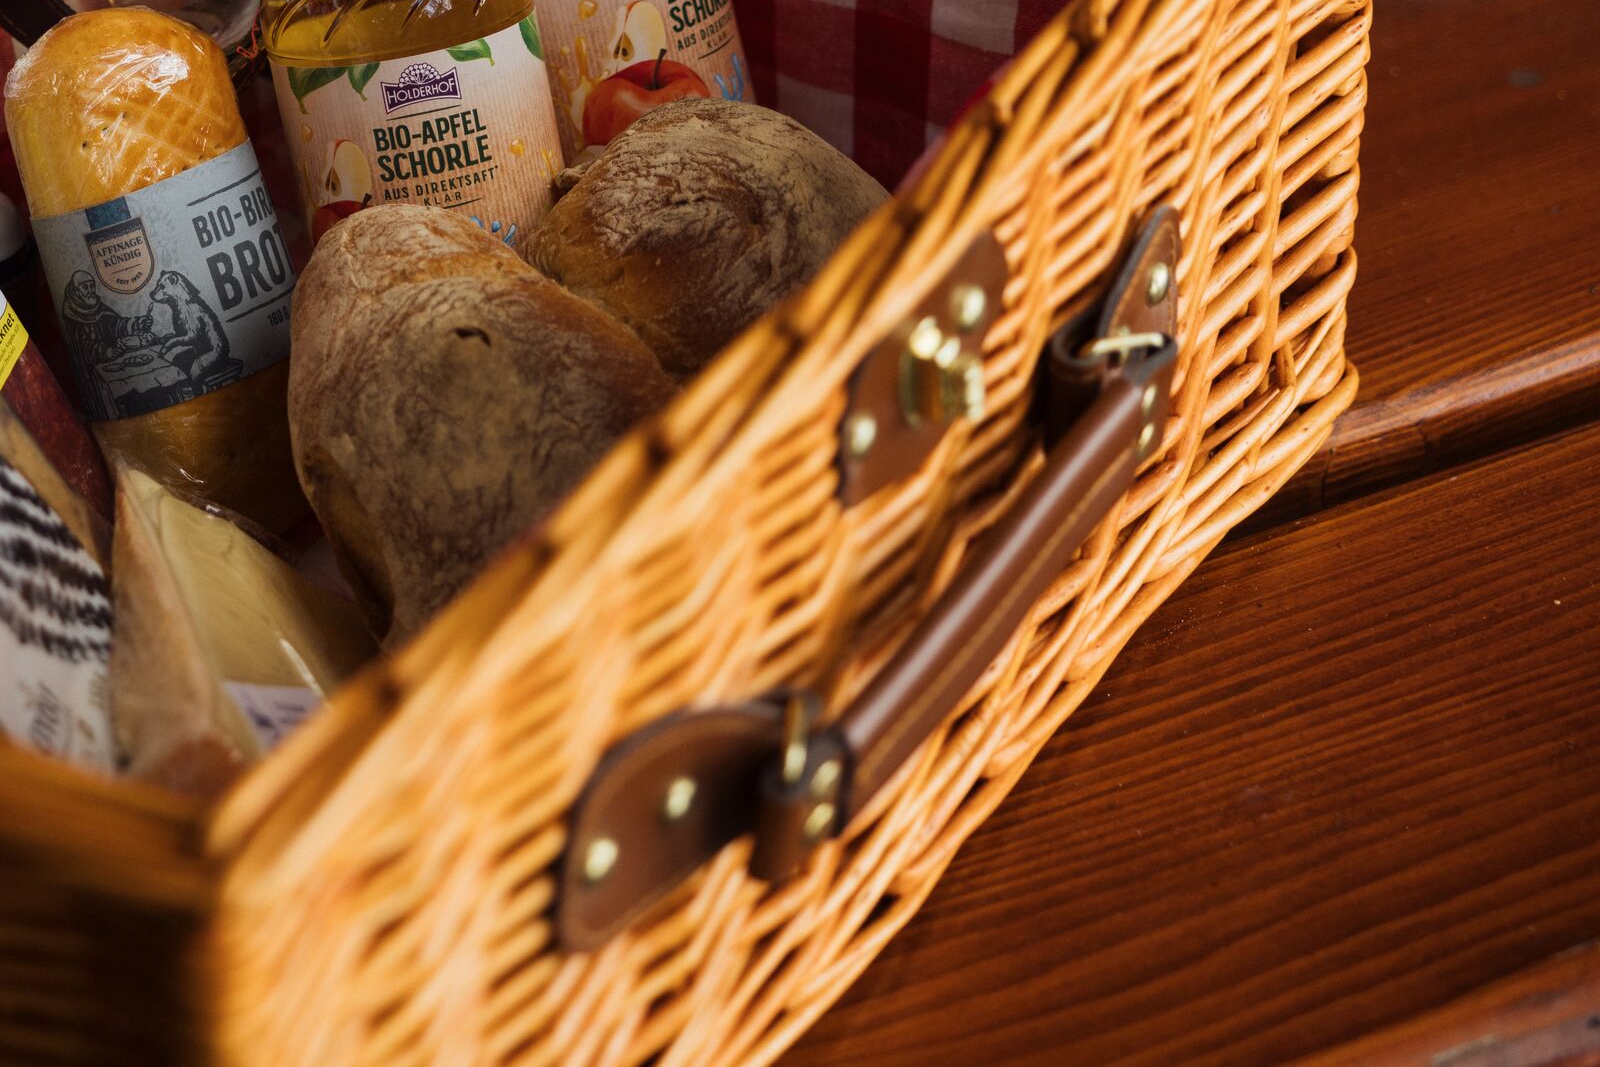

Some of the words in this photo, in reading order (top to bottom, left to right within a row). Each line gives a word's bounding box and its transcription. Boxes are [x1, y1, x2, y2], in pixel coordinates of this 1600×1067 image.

[677, 34, 697, 51] AUS
[386, 77, 456, 105] HOLDERHOF
[373, 108, 487, 153] BIO-APFEL
[377, 134, 493, 182] SCHORLE
[384, 186, 410, 201] AUS
[423, 191, 463, 207] KLAR
[191, 185, 274, 249] BIO-BIR
[95, 235, 144, 259] AFFINAGE
[103, 248, 142, 268] KÜNDIG
[205, 222, 295, 312] BROT
